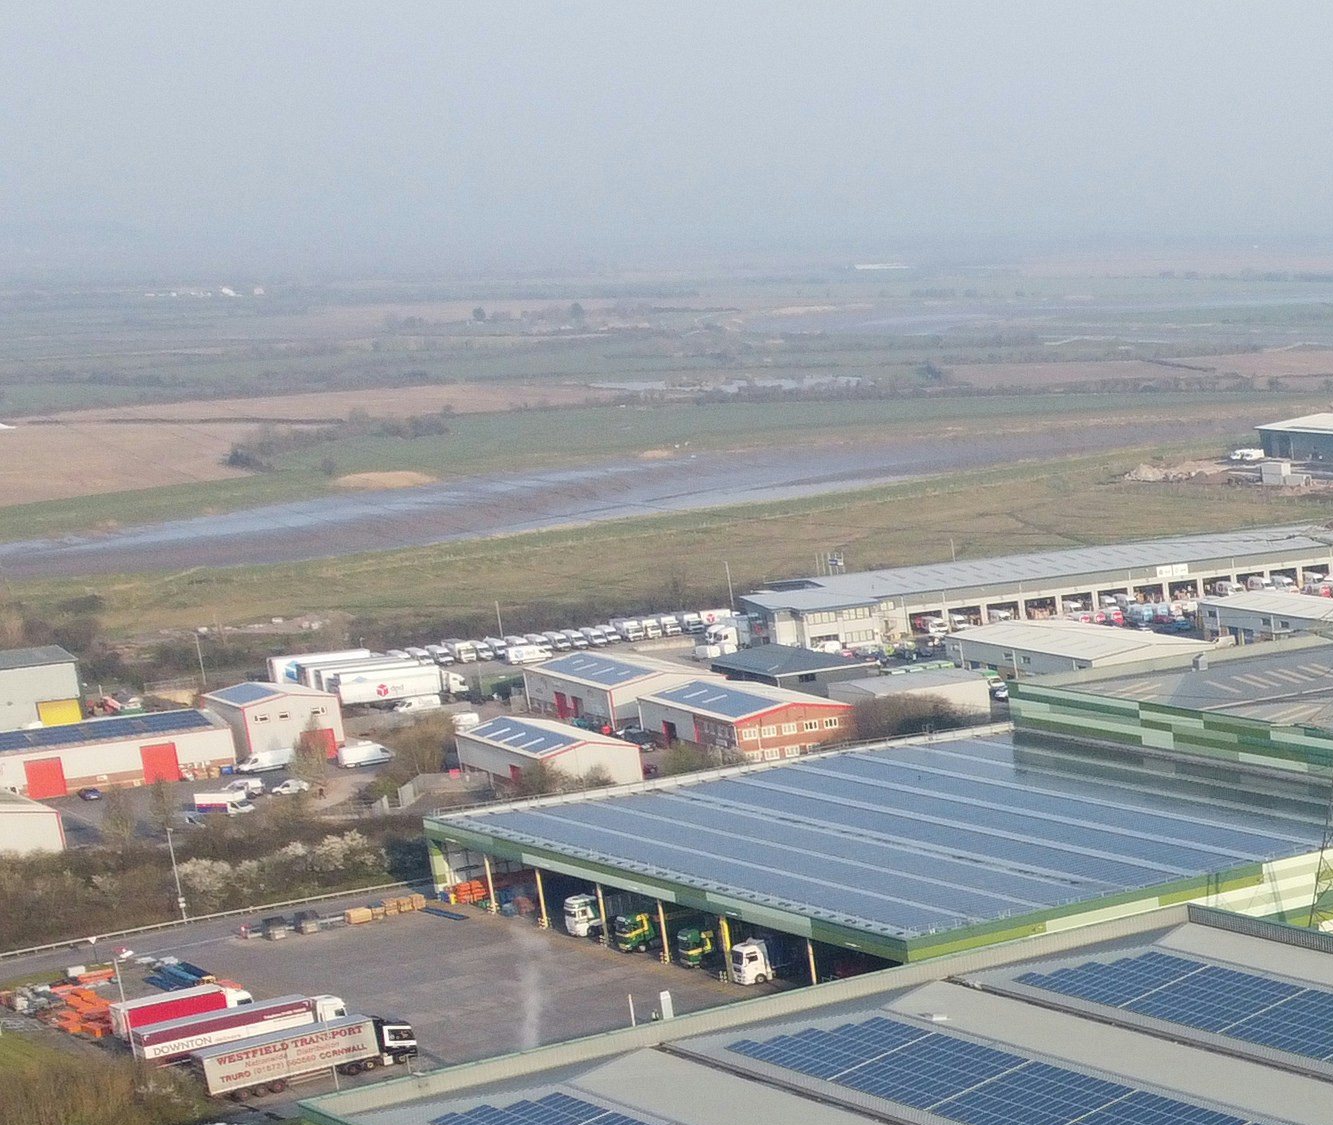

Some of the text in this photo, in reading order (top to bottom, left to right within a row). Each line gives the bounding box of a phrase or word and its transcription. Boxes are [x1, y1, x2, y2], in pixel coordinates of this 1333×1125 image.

[153, 1035, 213, 1057] DOWNTON
[216, 1039, 290, 1066] WESTFIELD
[220, 1070, 252, 1083] TRURO
[318, 1043, 368, 1061] CORNWALL
